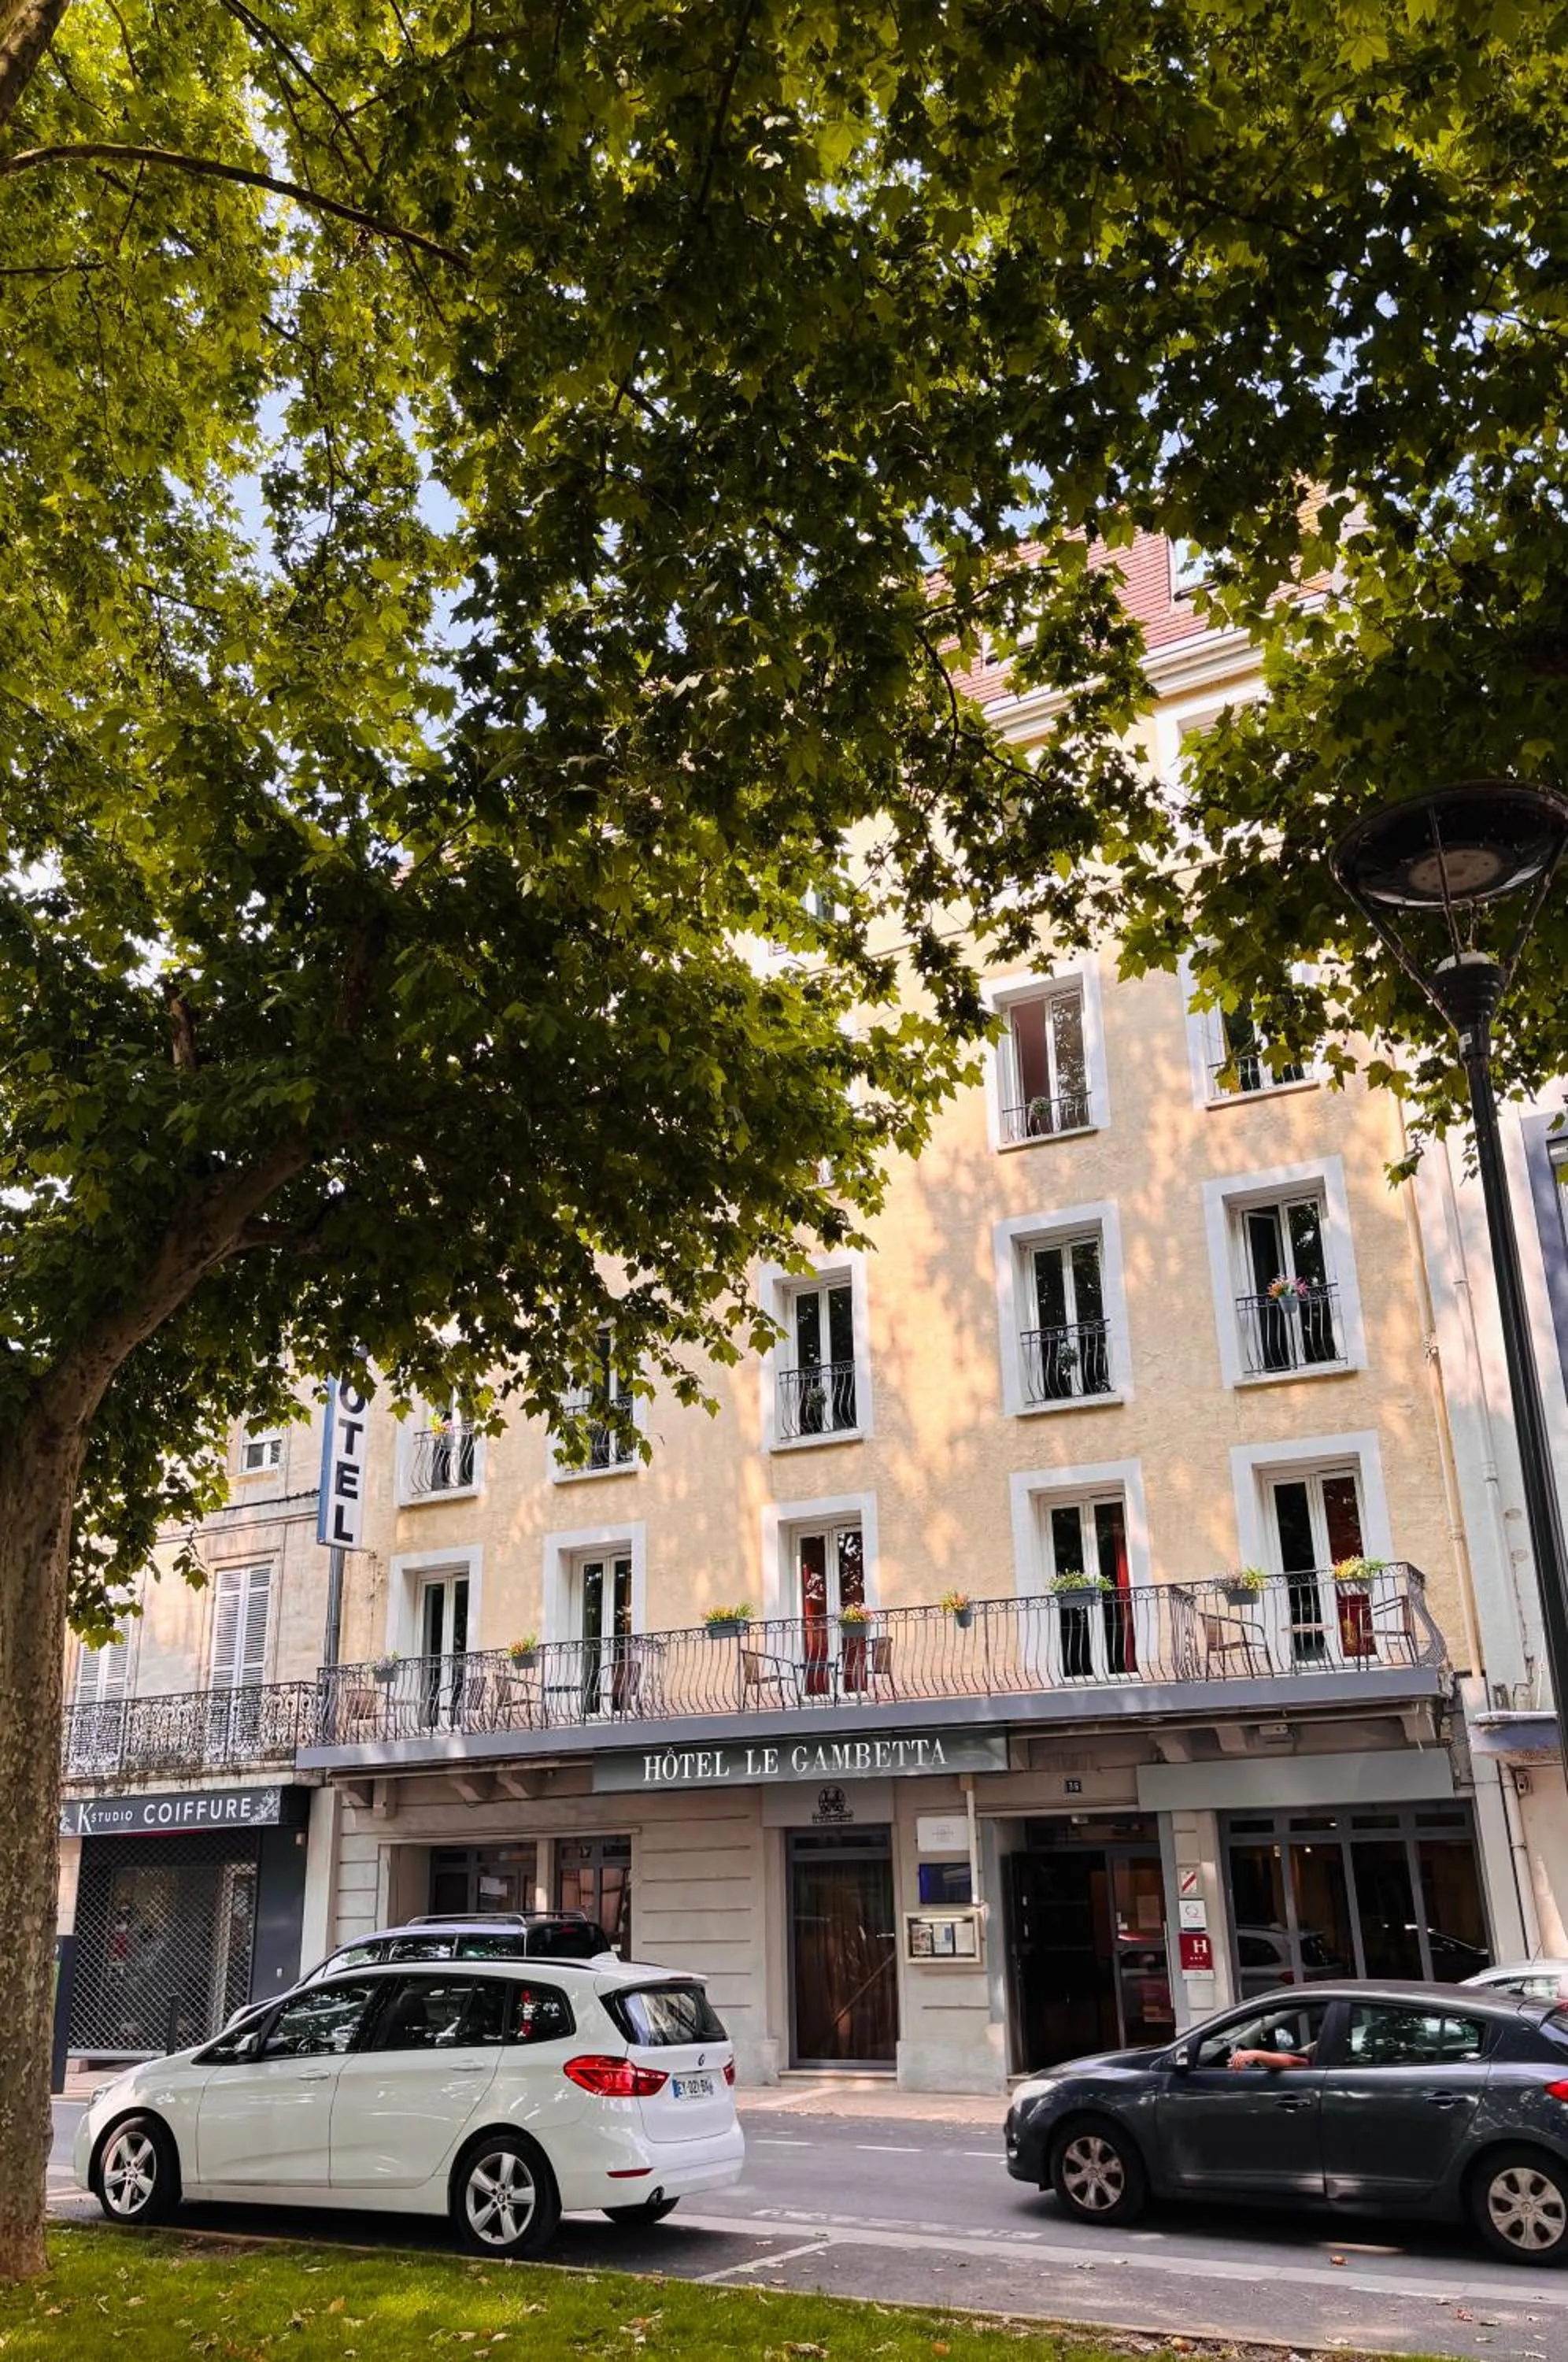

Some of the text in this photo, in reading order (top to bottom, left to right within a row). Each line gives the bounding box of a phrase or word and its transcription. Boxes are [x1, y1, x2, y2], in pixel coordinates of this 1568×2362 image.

[334, 1373, 366, 1542] OTEL
[643, 1738, 948, 1781] HÔTEL LE GAMBETTA
[142, 1797, 252, 1824] COIFFURE
[1193, 1940, 1208, 1953] H
